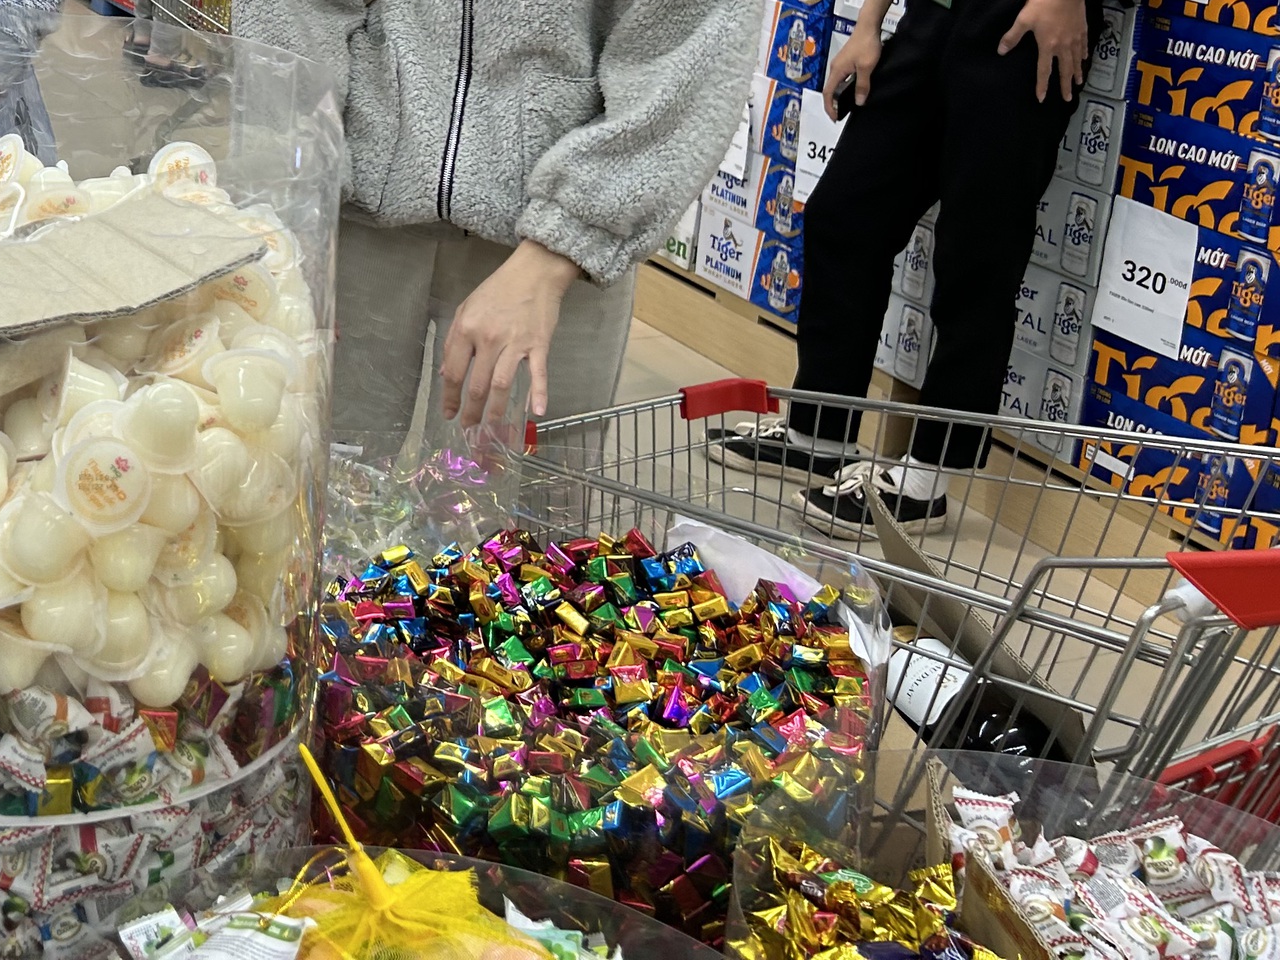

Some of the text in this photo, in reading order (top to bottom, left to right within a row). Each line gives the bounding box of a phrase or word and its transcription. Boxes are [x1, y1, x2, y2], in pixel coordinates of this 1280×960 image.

[1167, 38, 1260, 71] LON CAO MỚI
[1148, 135, 1241, 172] LON CAO MỚI
[711, 184, 747, 208] PLATINUM
[1244, 183, 1275, 209] Tiger
[710, 234, 743, 262] Tiger
[1197, 246, 1230, 268] MỚI
[705, 255, 742, 282] PLATINUM
[1122, 260, 1188, 294] 320 .000đ
[1232, 281, 1265, 307] Tiger
[1179, 344, 1211, 368] MỚI
[1214, 379, 1247, 407] Tiger
